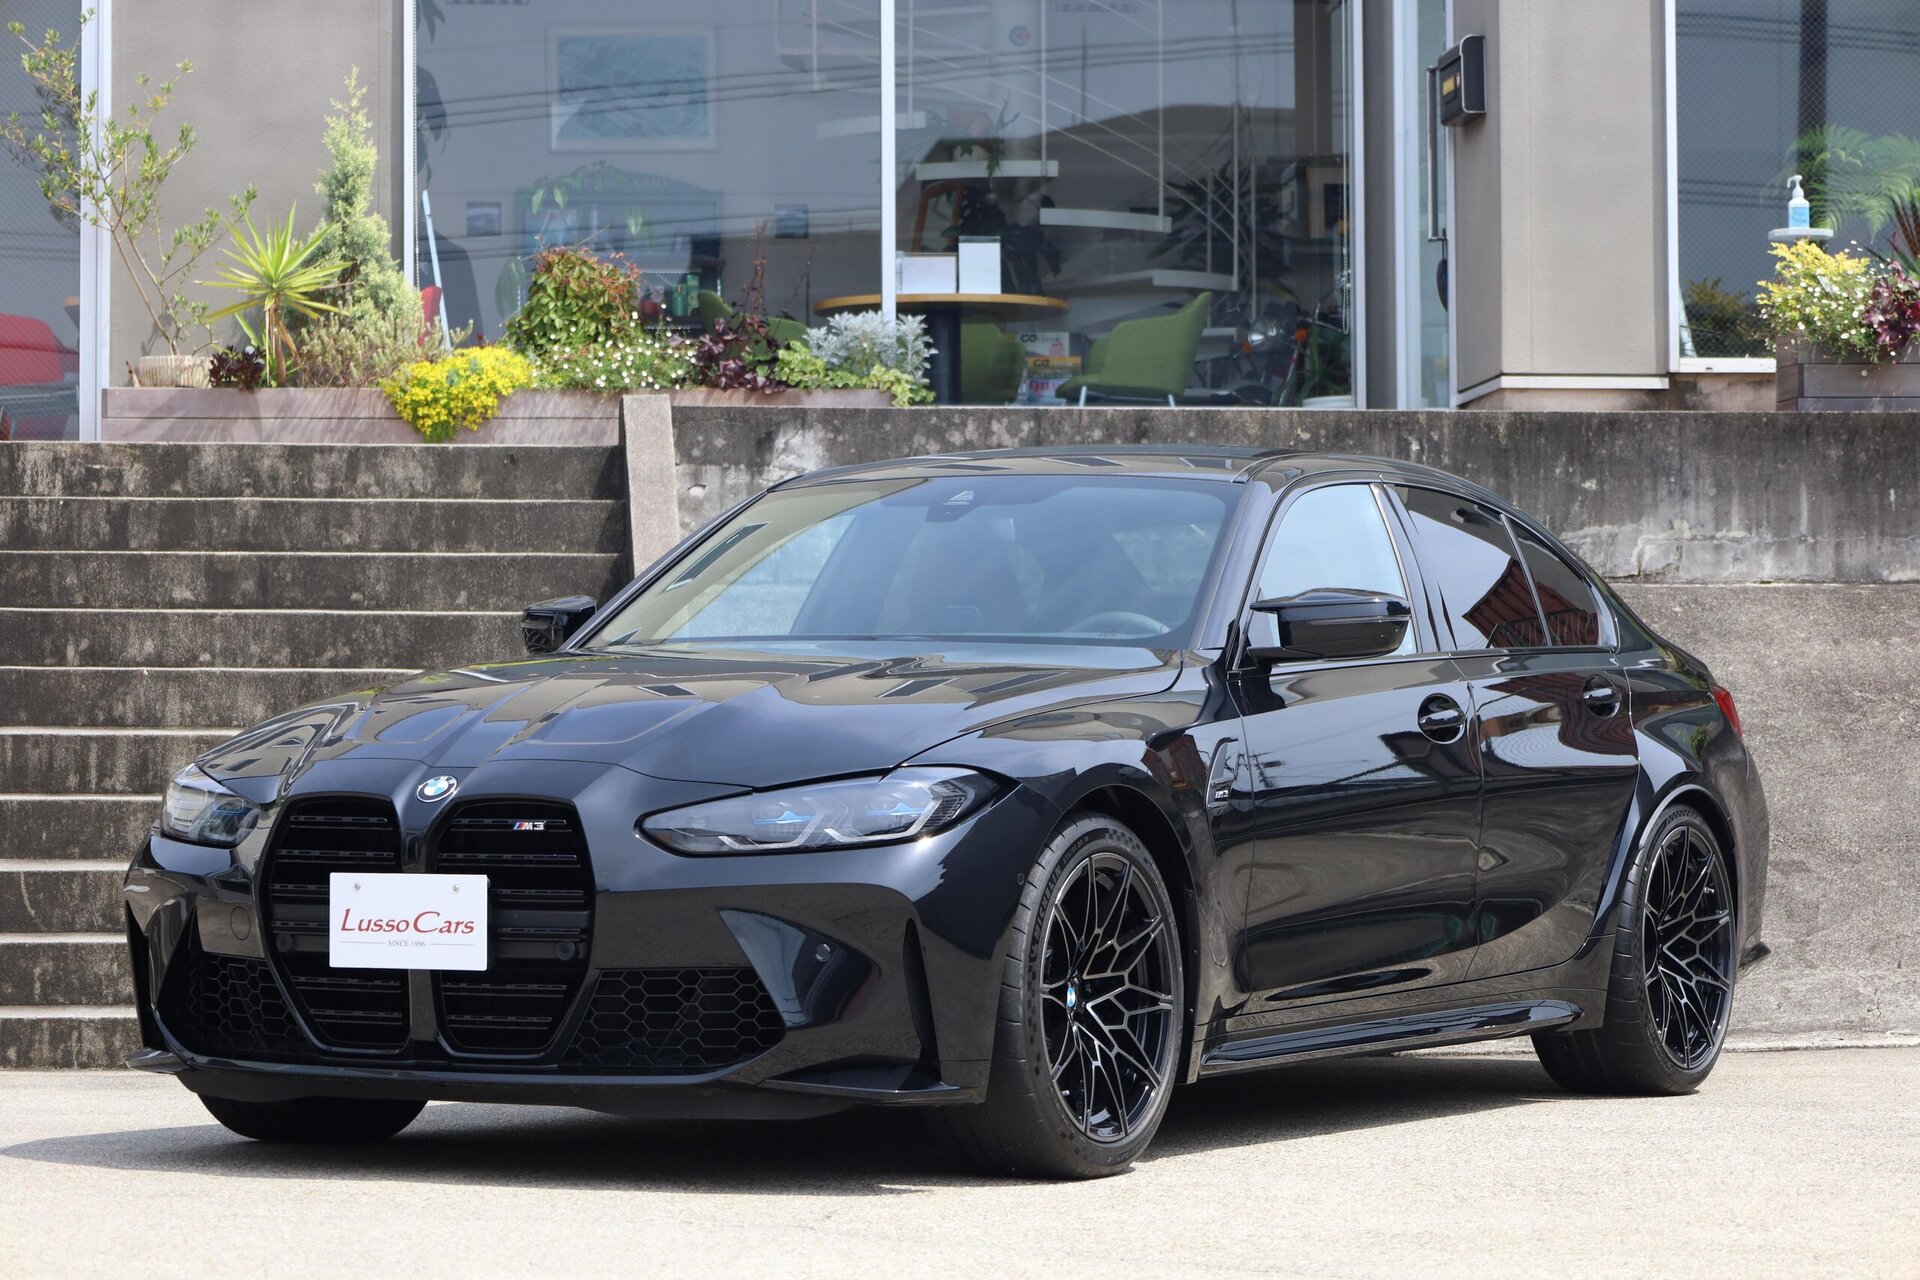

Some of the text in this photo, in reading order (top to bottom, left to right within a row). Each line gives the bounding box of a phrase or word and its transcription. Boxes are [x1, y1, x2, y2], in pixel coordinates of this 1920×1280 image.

[519, 821, 546, 831] M3
[340, 908, 475, 935] Lusso Cars
